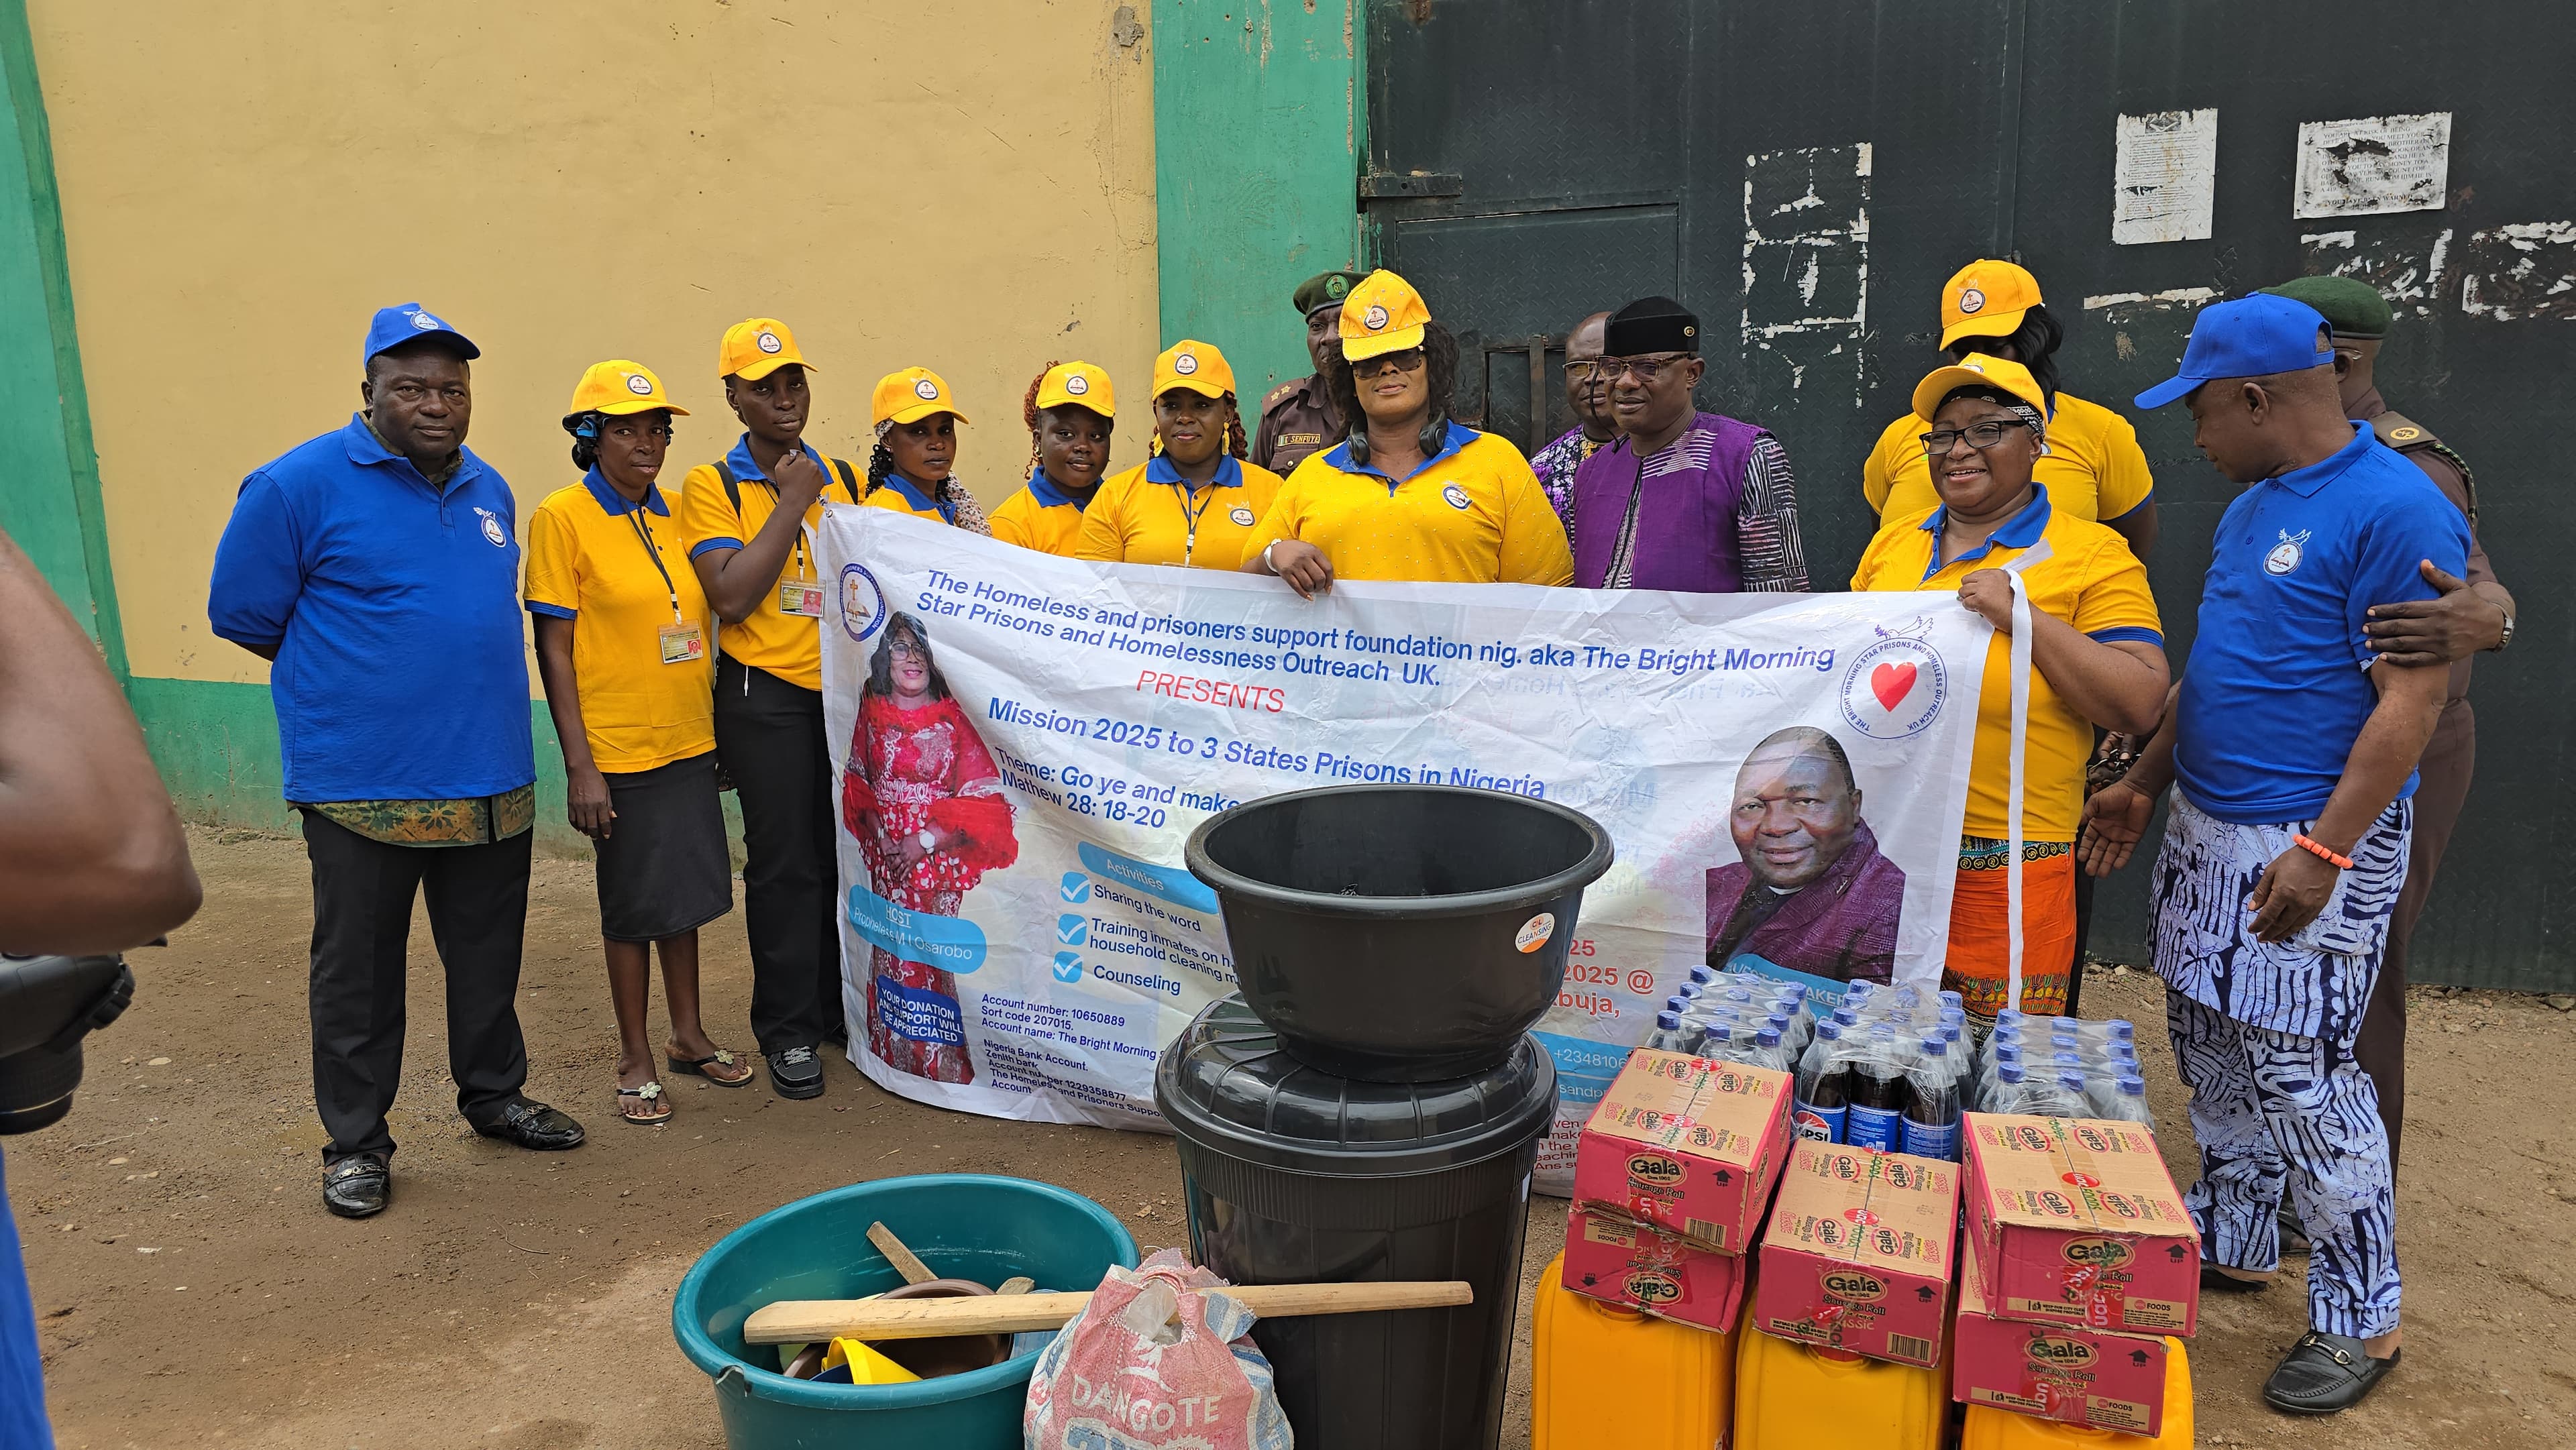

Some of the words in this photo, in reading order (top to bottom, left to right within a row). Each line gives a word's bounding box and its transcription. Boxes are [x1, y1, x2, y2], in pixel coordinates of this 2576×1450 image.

[928, 569, 968, 594] The
[974, 581, 1090, 620] Homeless
[1095, 610, 1138, 629] and
[1141, 614, 1246, 641] prisoners
[1251, 626, 1338, 651] support
[1344, 629, 1474, 661] foundation
[1479, 640, 1522, 669] nig.
[1529, 644, 1574, 667] aka
[1582, 646, 1631, 670] The
[1637, 648, 1716, 676] Bright
[1723, 646, 1836, 673] Morning
[917, 592, 965, 616] Star
[969, 604, 1055, 636] Prisons
[1060, 627, 1105, 647] and
[1109, 632, 1276, 671] Homelessness
[1283, 653, 1390, 682] Outreach
[1402, 663, 1440, 686] UK.
[1879, 640, 1911, 653] PRISONS
[1912, 643, 1927, 654] AND
[1861, 648, 1879, 665] STAR
[1925, 651, 1943, 687] HOMELESS
[1136, 670, 1286, 713] PRESENTS
[1845, 663, 1862, 696] MORNING
[1844, 696, 1858, 720] BRIGHT
[1920, 689, 1943, 724] OUTREACH
[1855, 718, 1870, 732] THE
[1907, 721, 1920, 731] UK
[988, 698, 1087, 737] Mission
[1093, 718, 1163, 750] 2025
[1169, 730, 1195, 756] to
[1200, 737, 1219, 759] 3
[1224, 740, 1308, 773] States
[1315, 752, 1411, 784] Prisons
[1419, 763, 1442, 785] in
[1450, 767, 1545, 799] Nigeria
[995, 746, 1056, 783] Theme:
[1061, 766, 1094, 789] Go
[1099, 777, 1127, 796] ye
[1132, 785, 1176, 805] and
[1002, 769, 1063, 806] Mathew
[1067, 792, 1097, 817] 28:
[1104, 799, 1167, 829] 18-20
[1107, 858, 1164, 891] Activities
[885, 905, 912, 926] HOST
[1094, 884, 1142, 913] Sharing
[1144, 901, 1165, 919] the
[1167, 912, 1202, 932] word
[914, 936, 973, 959] Osarobo
[1091, 917, 1148, 942] Training
[1150, 930, 1199, 958] inmates
[1201, 951, 1218, 964] on
[1517, 923, 1552, 944] CLEANSING
[1090, 935, 1166, 960] household
[1170, 952, 1222, 981] cleaning
[1093, 965, 1181, 996] Counseling
[1564, 964, 1619, 986] 2025
[1626, 969, 1654, 995] @
[879, 998, 894, 1013] AND
[894, 1007, 937, 1025] SUPPORT
[938, 1017, 963, 1034] WILL
[881, 987, 900, 1007] YOUR
[901, 999, 955, 1020] DONATION
[981, 993, 1024, 1010] Account
[1027, 1002, 1069, 1017] number:
[1071, 1008, 1126, 1027] 10650889
[1553, 989, 1620, 1018] buja,
[885, 1011, 894, 1024] BE
[893, 1017, 958, 1042] APPRECIATED
[981, 1005, 1003, 1019] Sort
[1005, 1011, 1031, 1023] code
[1033, 1015, 1073, 1031] 207015.
[981, 1017, 1022, 1034] Account
[1024, 1028, 1055, 1040] name:
[1058, 1031, 1077, 1044] The
[1080, 1036, 1112, 1052] Bright
[1113, 1041, 1157, 1061] Morning
[983, 1038, 1016, 1055] Nigeria
[1018, 1047, 1042, 1061] Bank
[1045, 1053, 1089, 1072] Account.
[985, 1049, 1015, 1064] Zenith
[1554, 1048, 1627, 1069] +2348106
[989, 1059, 1027, 1074] Account
[1065, 1080, 1126, 1102] 1229358877
[991, 1078, 1032, 1094] Account
[1674, 1061, 1686, 1078] Gala
[1721, 1074, 1734, 1093] Gala
[989, 1068, 1009, 1080] The
[1058, 1086, 1075, 1098] and
[1077, 1091, 1125, 1109] Prisoners
[1126, 1103, 1164, 1119] Suppo
[1558, 1084, 1605, 1099] sandp
[1554, 1120, 1580, 1129] ven
[1646, 1112, 1660, 1130] Gala
[1694, 1127, 1707, 1146] Gala
[1799, 1131, 1828, 1141] PSI
[1549, 1141, 1572, 1151] the
[2021, 1127, 2045, 1150] Gala
[2080, 1128, 2106, 1151] Gala
[1535, 1162, 1562, 1170] Ans
[1630, 1159, 1681, 1176] Gala
[1838, 1156, 1851, 1178] Gala
[1893, 1164, 1906, 1188] Gala
[1665, 1186, 1684, 1200] Roll
[2043, 1191, 2069, 1215] Gala
[2107, 1194, 2135, 1219] Gala
[1597, 1233, 1617, 1243] FOODS
[1821, 1220, 1836, 1245] Gala
[1880, 1230, 1894, 1255] Gala
[1825, 1276, 1881, 1293] Gala
[2112, 1272, 2133, 1282] Roll
[1865, 1303, 1886, 1315] Roll
[2147, 1302, 2171, 1311] FOODS
[2030, 1339, 2090, 1359] Gala
[2073, 1370, 2097, 1382] Roll
[1072, 1375, 1223, 1433] DANGOTE
[2108, 1402, 2133, 1412] FOODS
